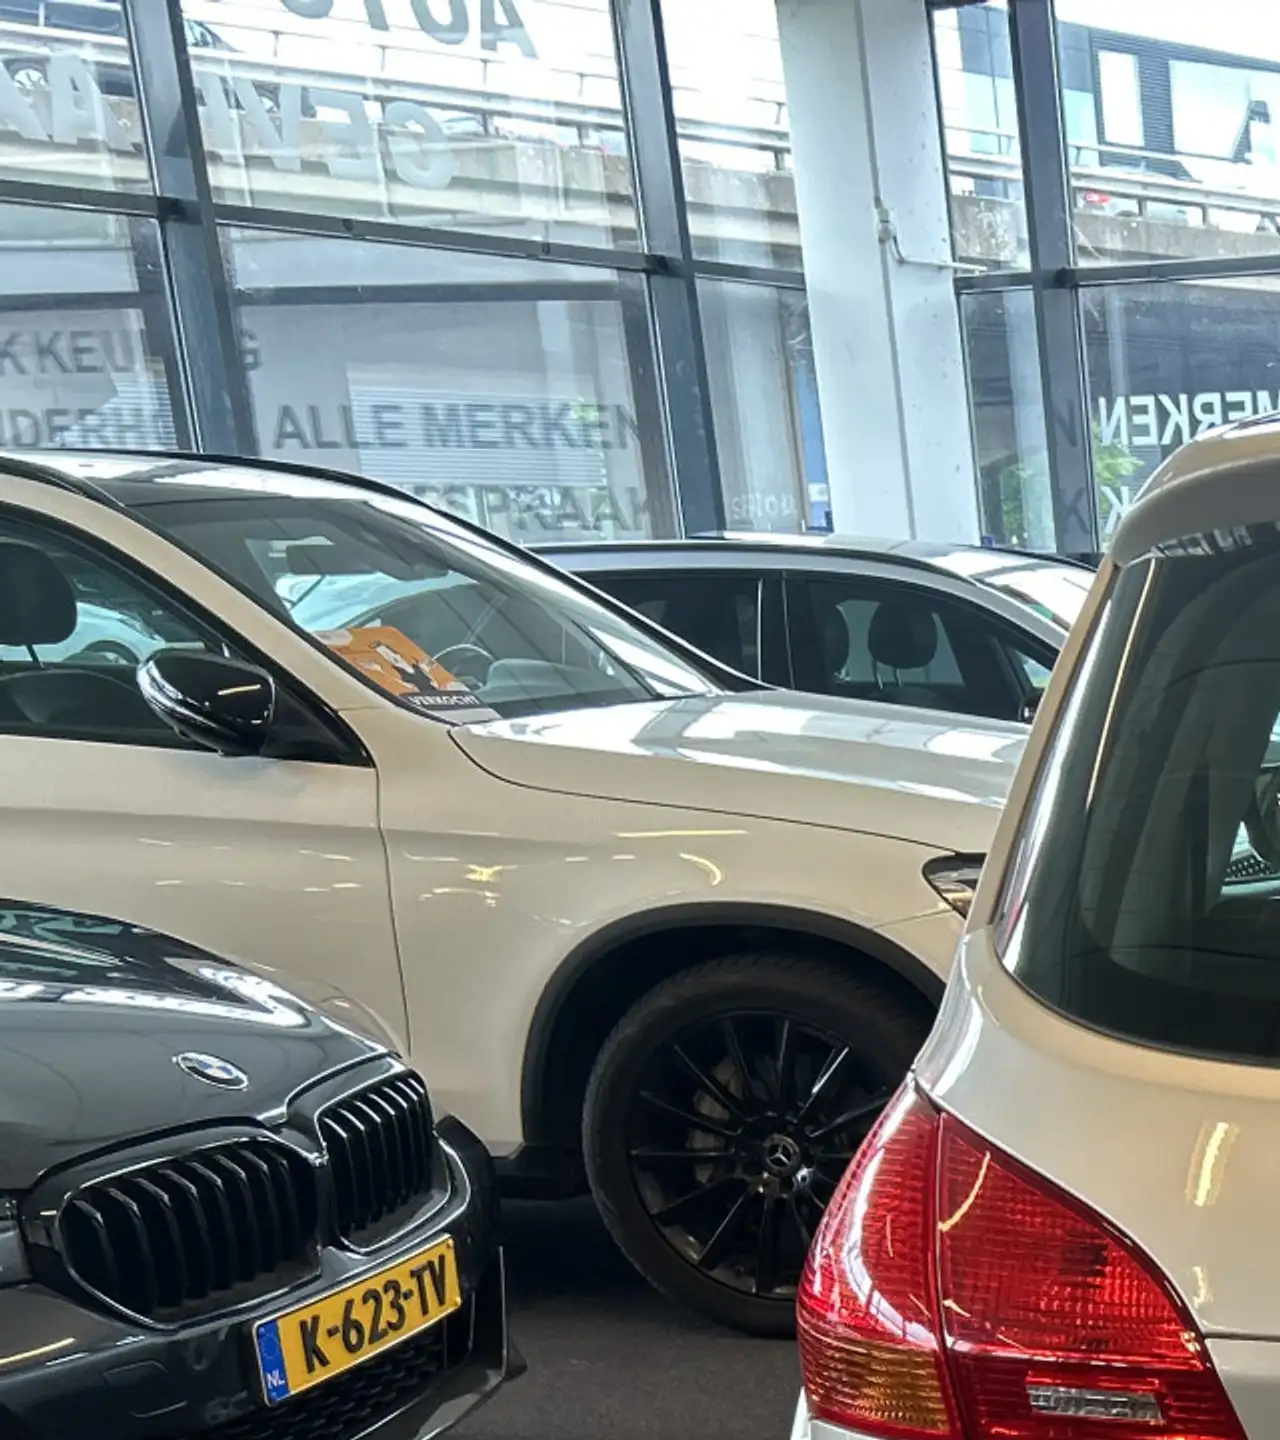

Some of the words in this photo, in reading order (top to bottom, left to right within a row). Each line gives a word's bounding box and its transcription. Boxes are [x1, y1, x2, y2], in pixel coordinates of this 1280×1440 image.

[272, 403, 408, 450] ALLE
[266, 1372, 286, 1388] NL
[298, 1253, 450, 1376] K-623-TV
